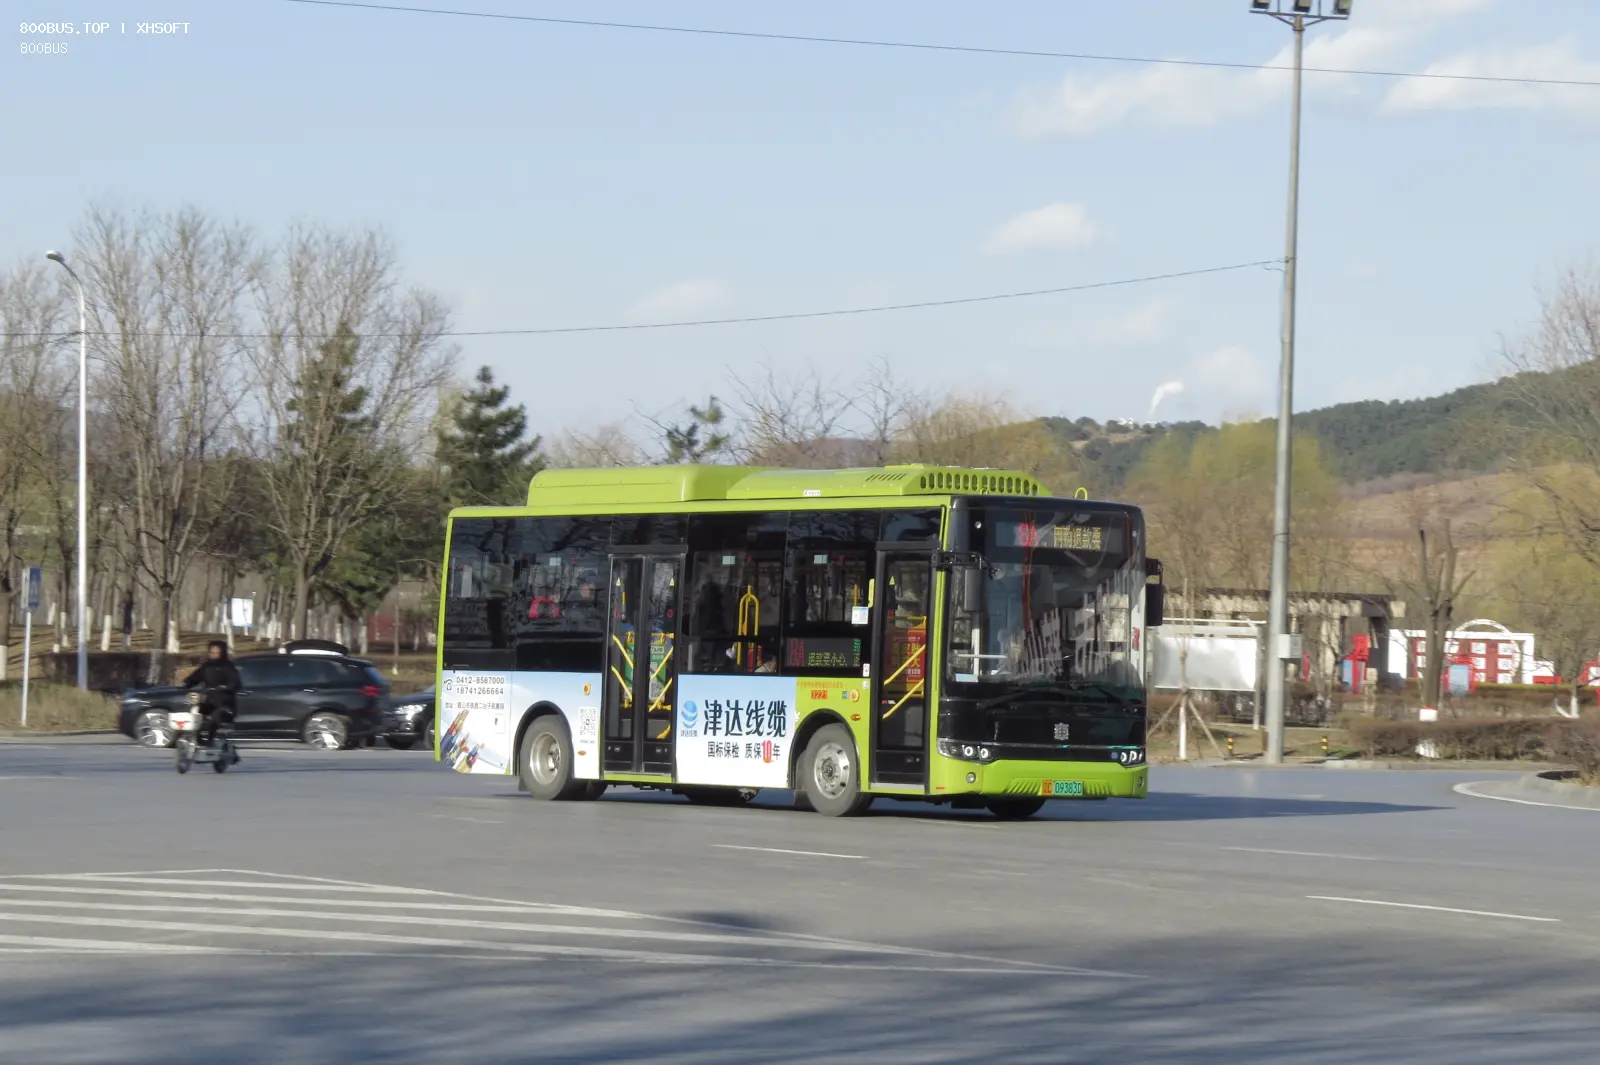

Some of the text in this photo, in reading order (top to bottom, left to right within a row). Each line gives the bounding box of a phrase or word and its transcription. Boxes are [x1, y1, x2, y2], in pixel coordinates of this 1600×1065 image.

[456, 676, 505, 684] 0412-8587000
[456, 687, 504, 695] 18741266664
[703, 699, 787, 738] 津达线缆
[707, 741, 740, 759] 国标保检
